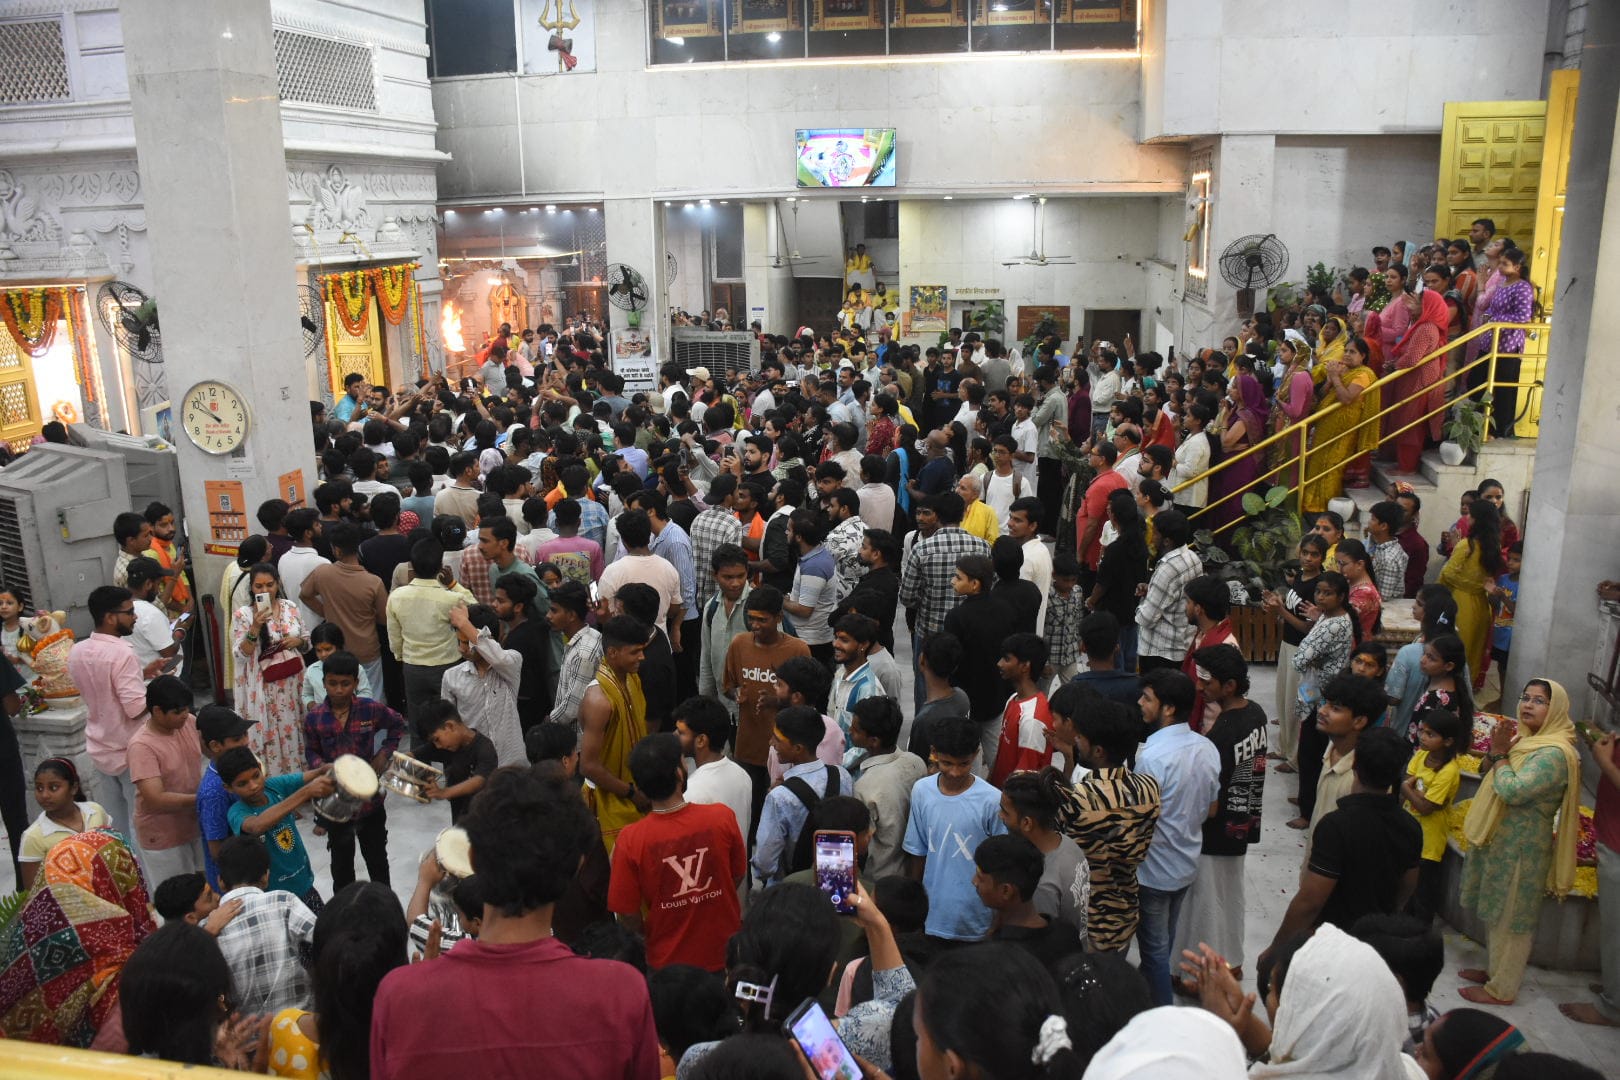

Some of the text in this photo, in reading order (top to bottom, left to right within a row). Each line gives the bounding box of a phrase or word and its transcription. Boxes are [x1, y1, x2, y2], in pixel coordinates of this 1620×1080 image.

[198, 391, 206, 401] 11
[208, 387, 217, 397] 12
[191, 400, 200, 410] 10
[231, 399, 238, 409] 2
[188, 413, 195, 423] 9
[236, 412, 243, 422] 3
[194, 426, 201, 436] 8
[235, 426, 241, 434] 4
[205, 435, 212, 445] 7
[216, 438, 223, 448] 6
[227, 435, 234, 445] 5
[742, 667, 778, 684] adida
[661, 898, 688, 909] LOUIS
